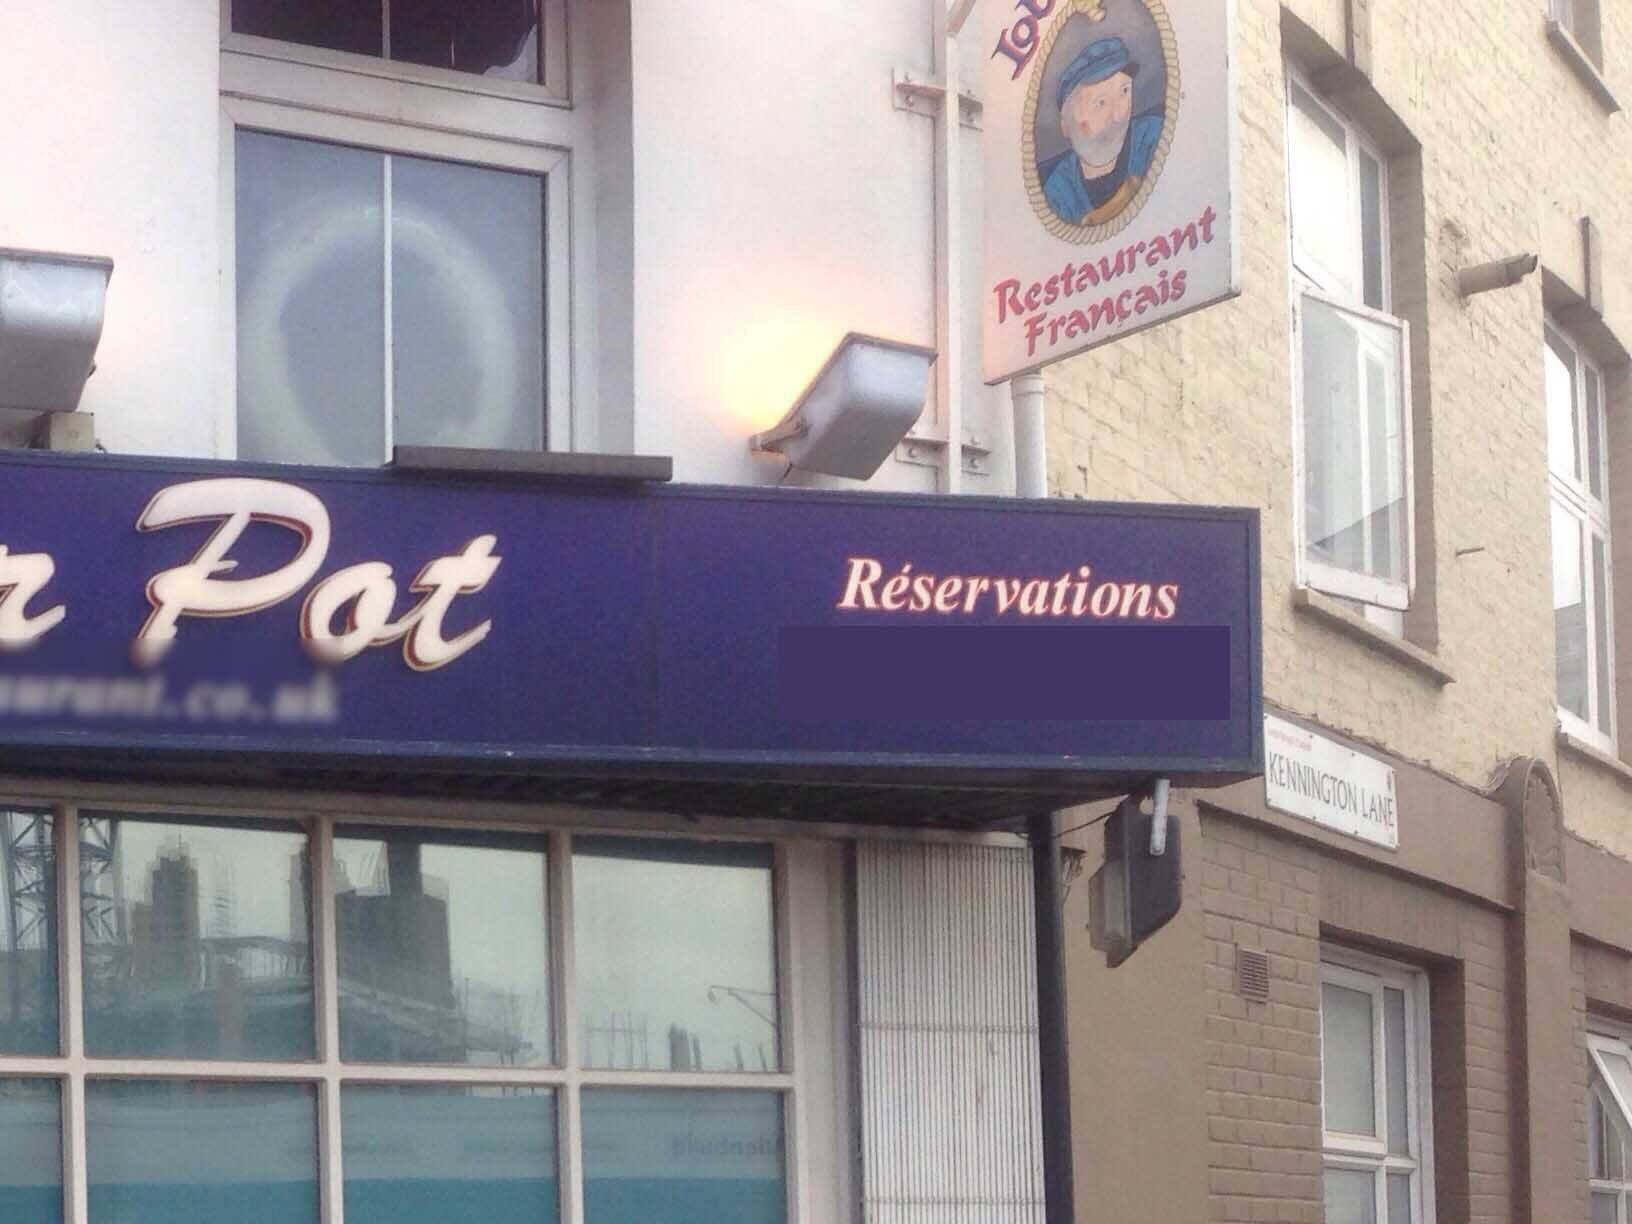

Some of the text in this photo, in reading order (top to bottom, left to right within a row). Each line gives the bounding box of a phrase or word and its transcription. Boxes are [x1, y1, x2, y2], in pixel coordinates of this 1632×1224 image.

[993, 206, 1217, 323] Restaurant
[136, 475, 503, 672] Pot
[837, 556, 1178, 620] Réservations
[1268, 752, 1359, 817] KENNINGTON
[1360, 787, 1394, 827] LANE
